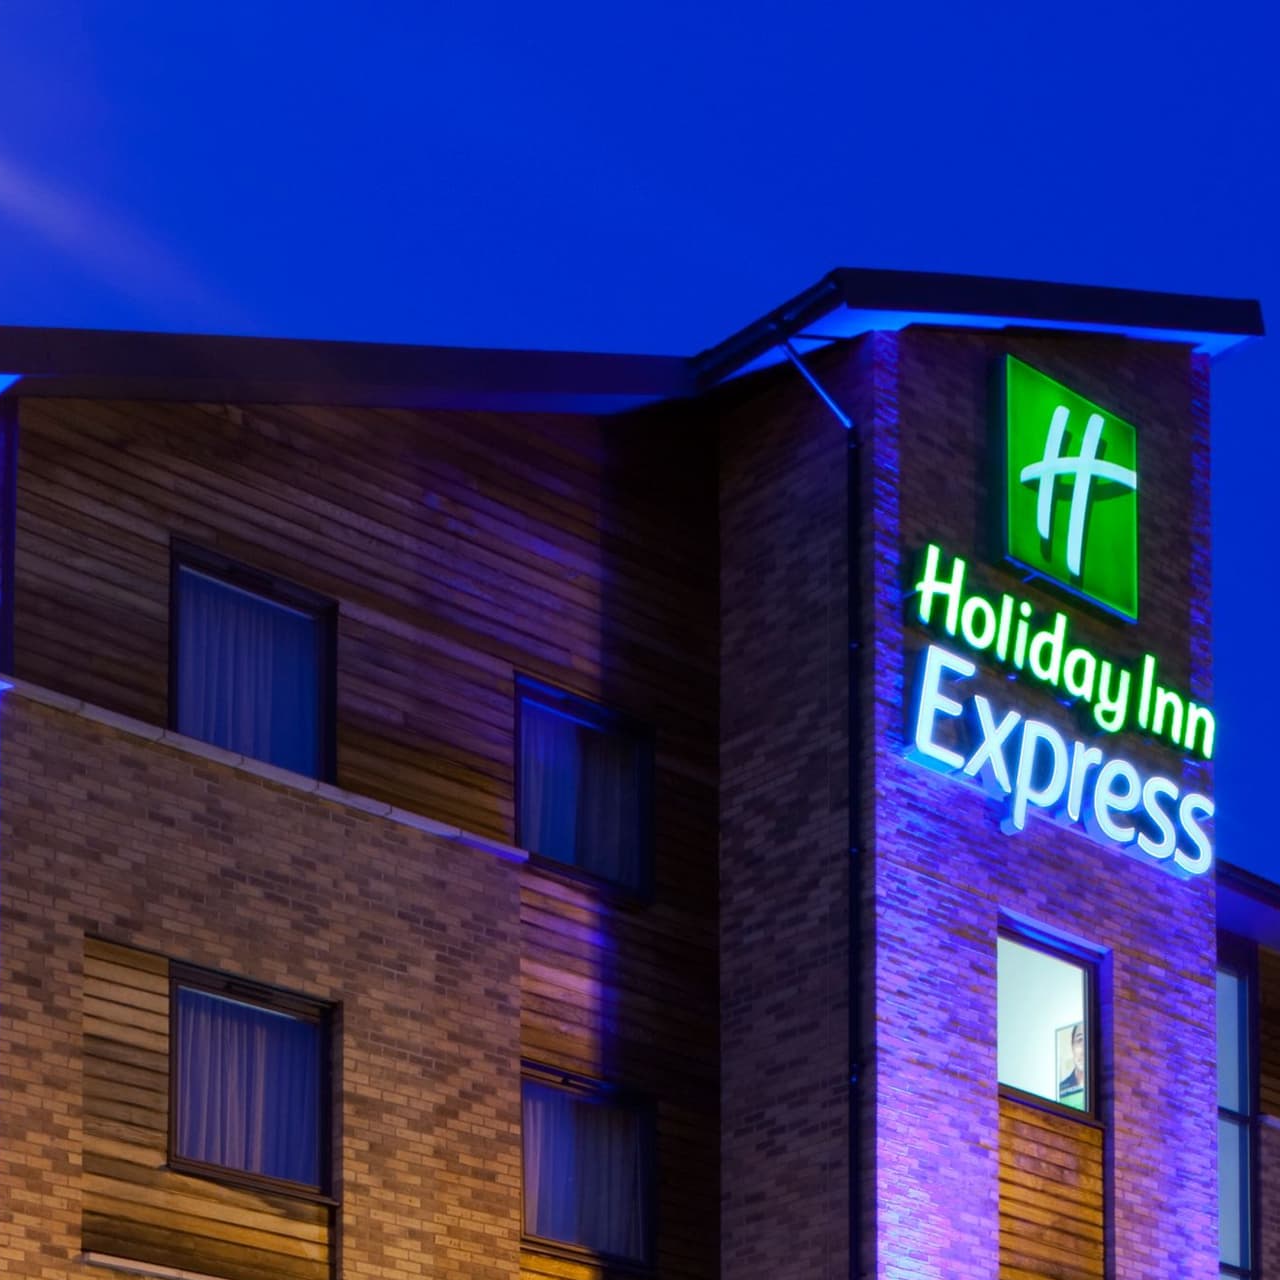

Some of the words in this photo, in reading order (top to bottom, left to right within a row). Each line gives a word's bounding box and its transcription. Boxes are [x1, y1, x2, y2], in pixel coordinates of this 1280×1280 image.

[914, 644, 1216, 876] Express
[915, 543, 1131, 733] Holiday
[1138, 654, 1216, 759] Inn
